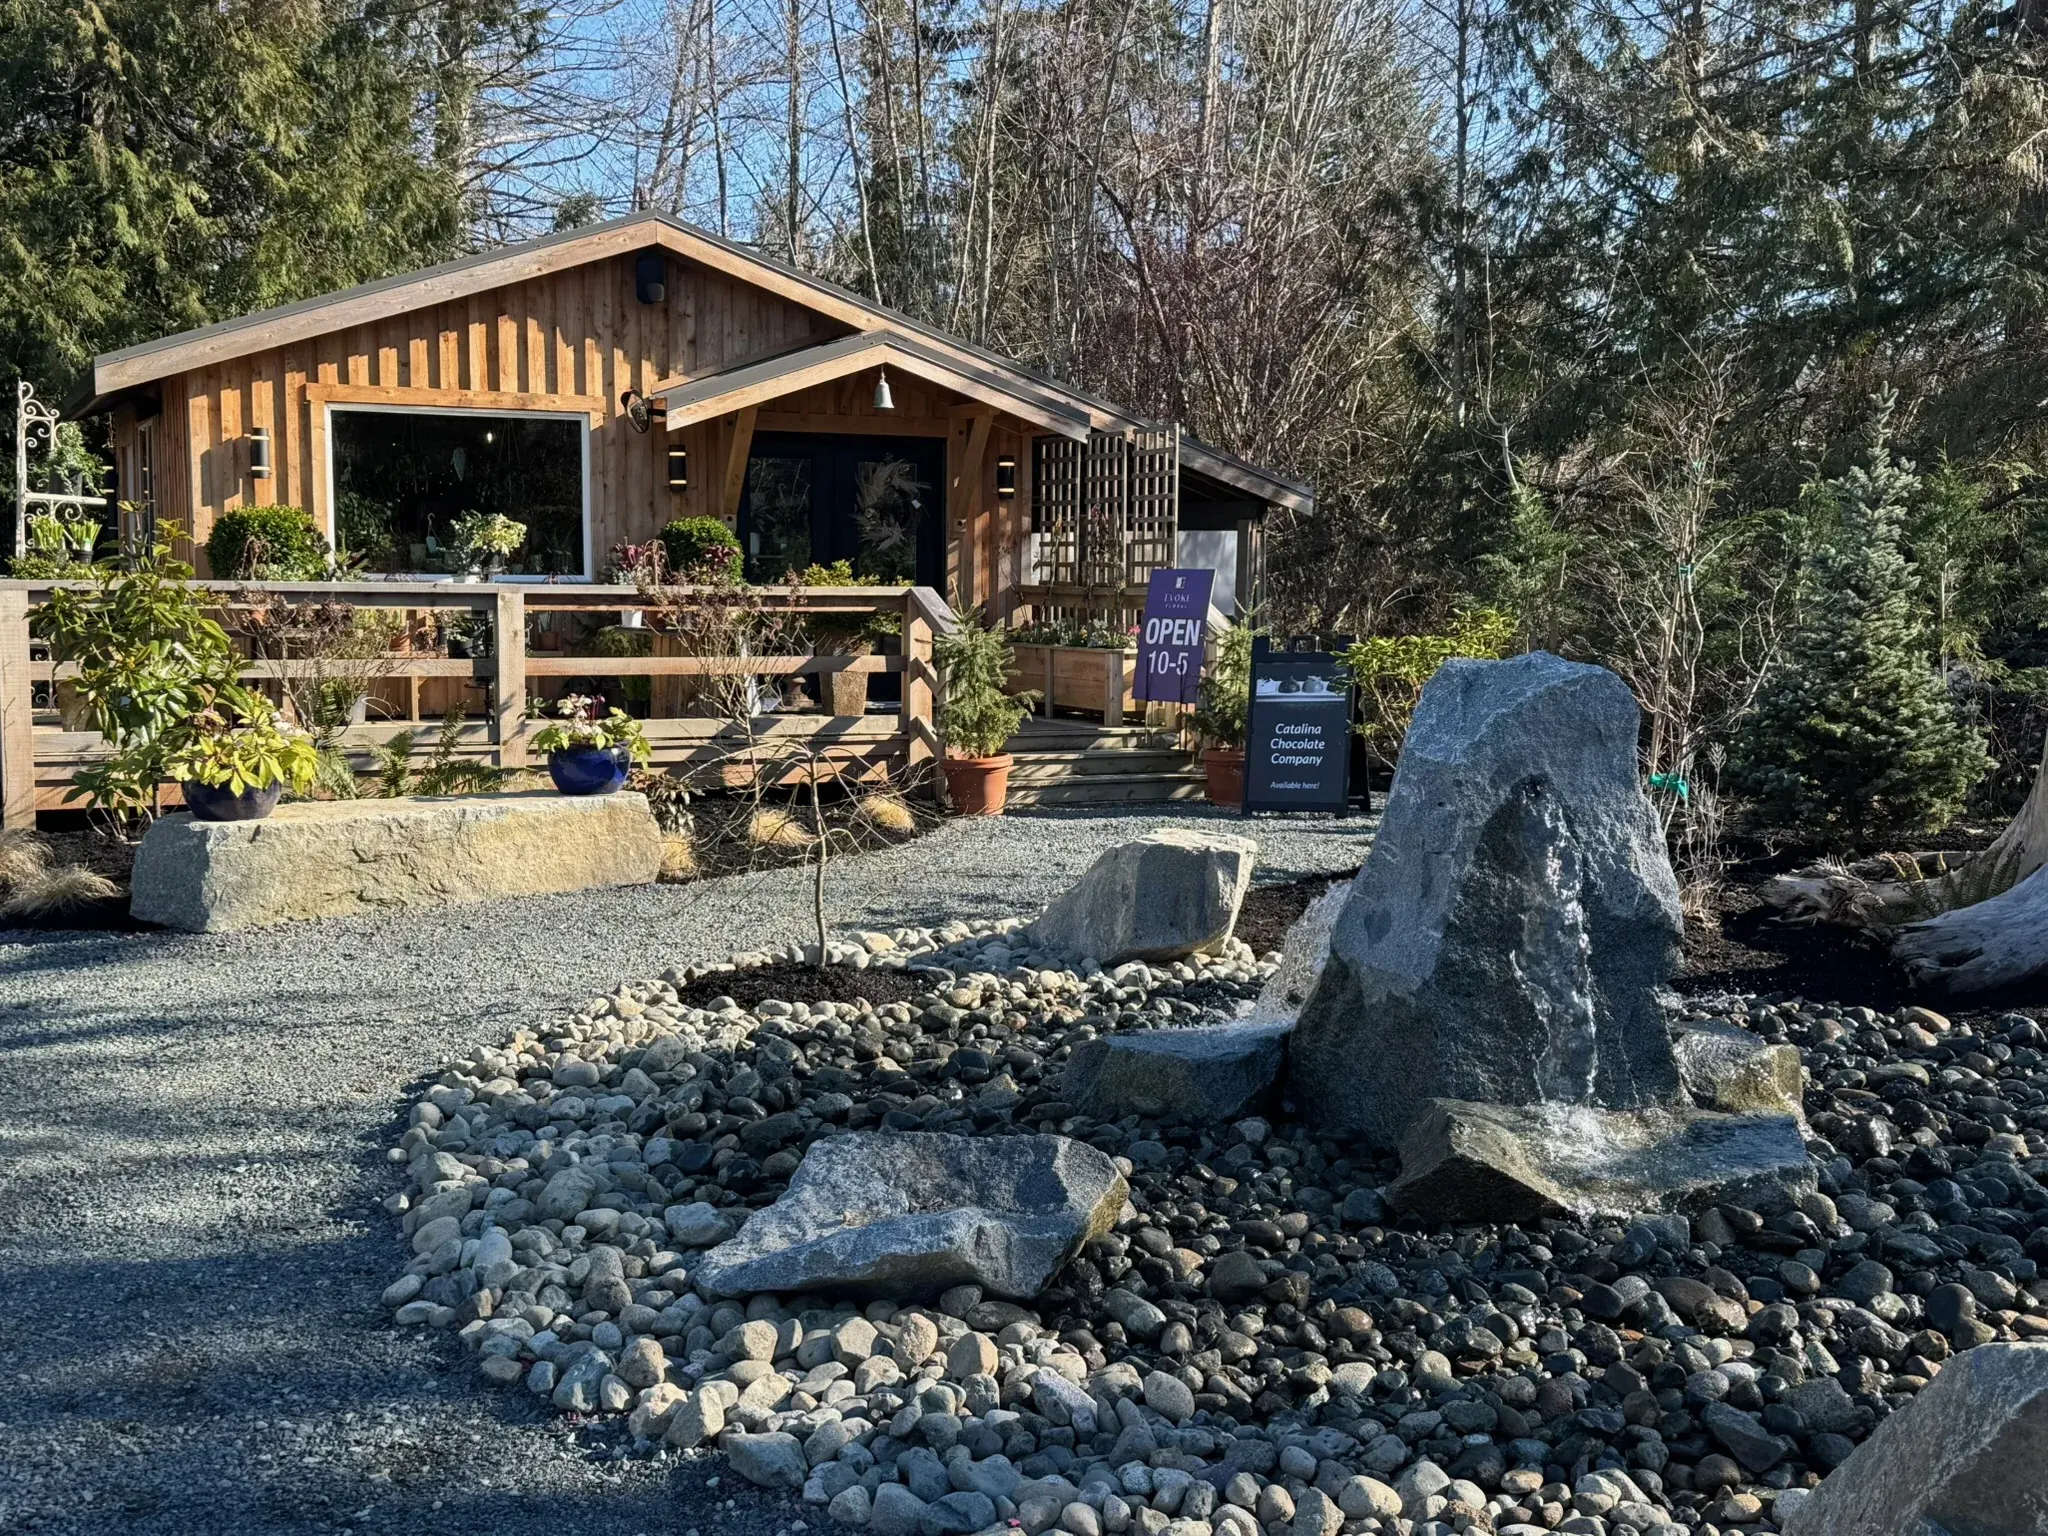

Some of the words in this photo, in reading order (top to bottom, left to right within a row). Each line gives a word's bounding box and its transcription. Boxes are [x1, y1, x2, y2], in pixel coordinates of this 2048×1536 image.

[1145, 618, 1201, 646] OPEN
[1148, 650, 1189, 675] 10-5
[1275, 723, 1322, 735] Catalina
[1270, 738, 1326, 749] Chocolate
[1271, 753, 1323, 766] Company
[1270, 781, 1301, 789] Available
[1302, 781, 1320, 789] here!
